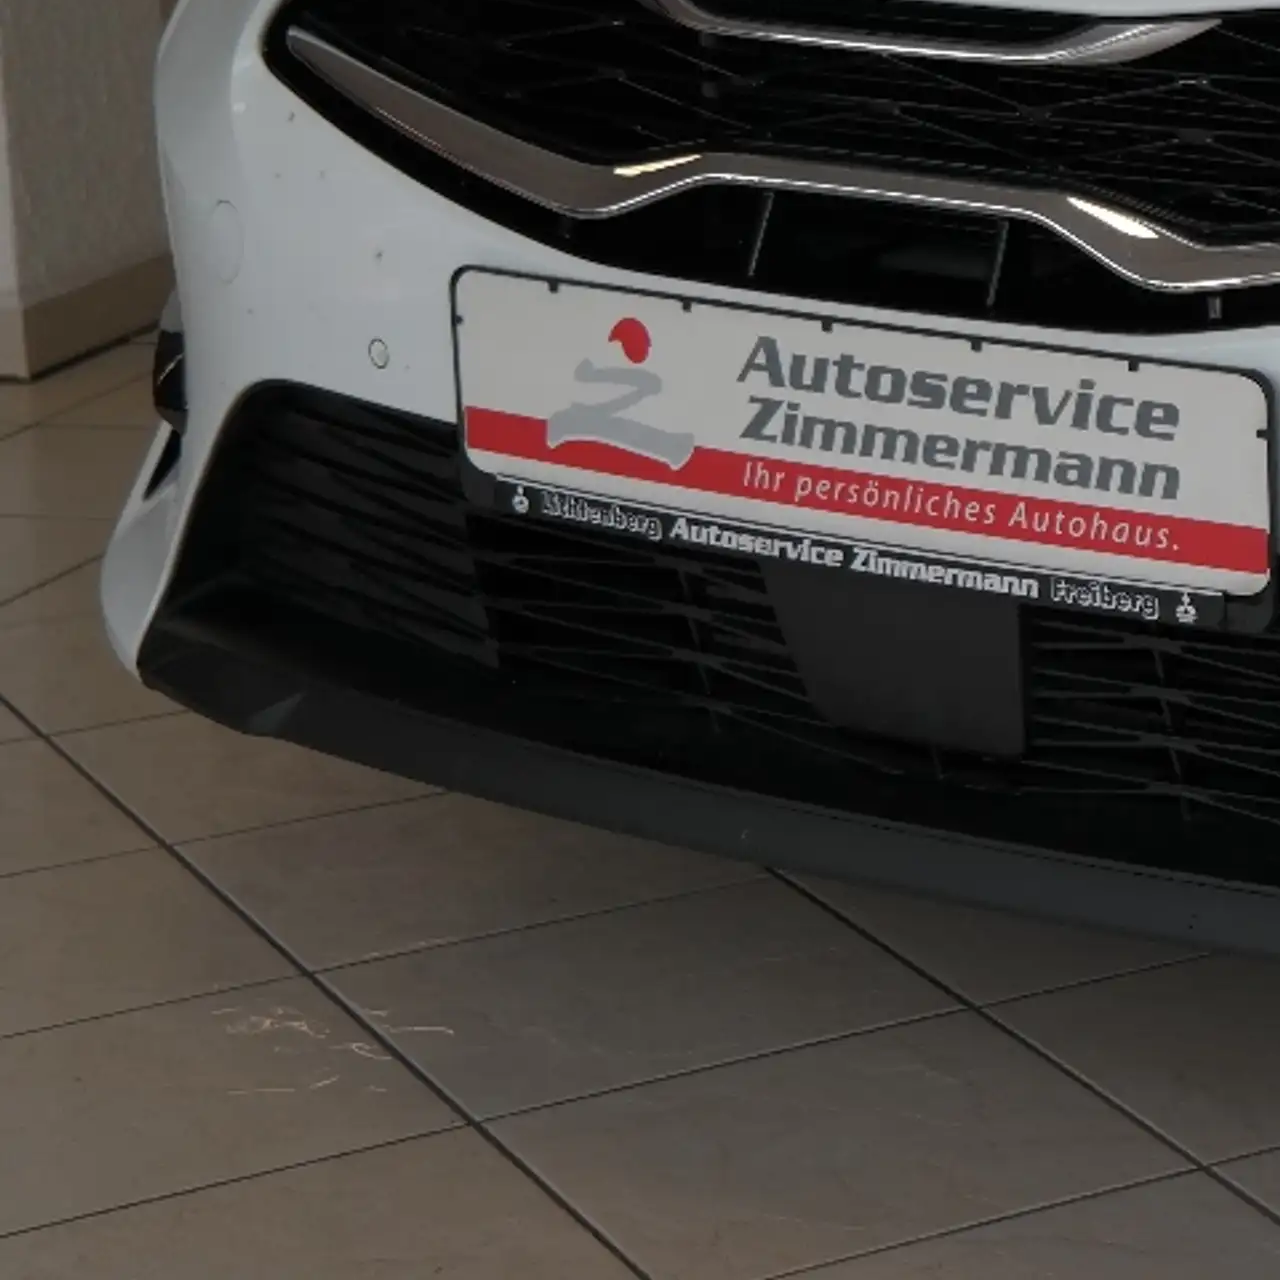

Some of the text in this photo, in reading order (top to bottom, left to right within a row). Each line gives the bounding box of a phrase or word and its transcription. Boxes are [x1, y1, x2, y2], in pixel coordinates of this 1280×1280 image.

[736, 334, 1181, 442] Autoservice
[739, 395, 1181, 500] Zimmermann
[742, 460, 1180, 551] Ihr persönliches Autohaus.
[669, 516, 845, 568] Autoservice
[850, 545, 1040, 599] Zimmermann
[1050, 576, 1160, 621] Freiberg
